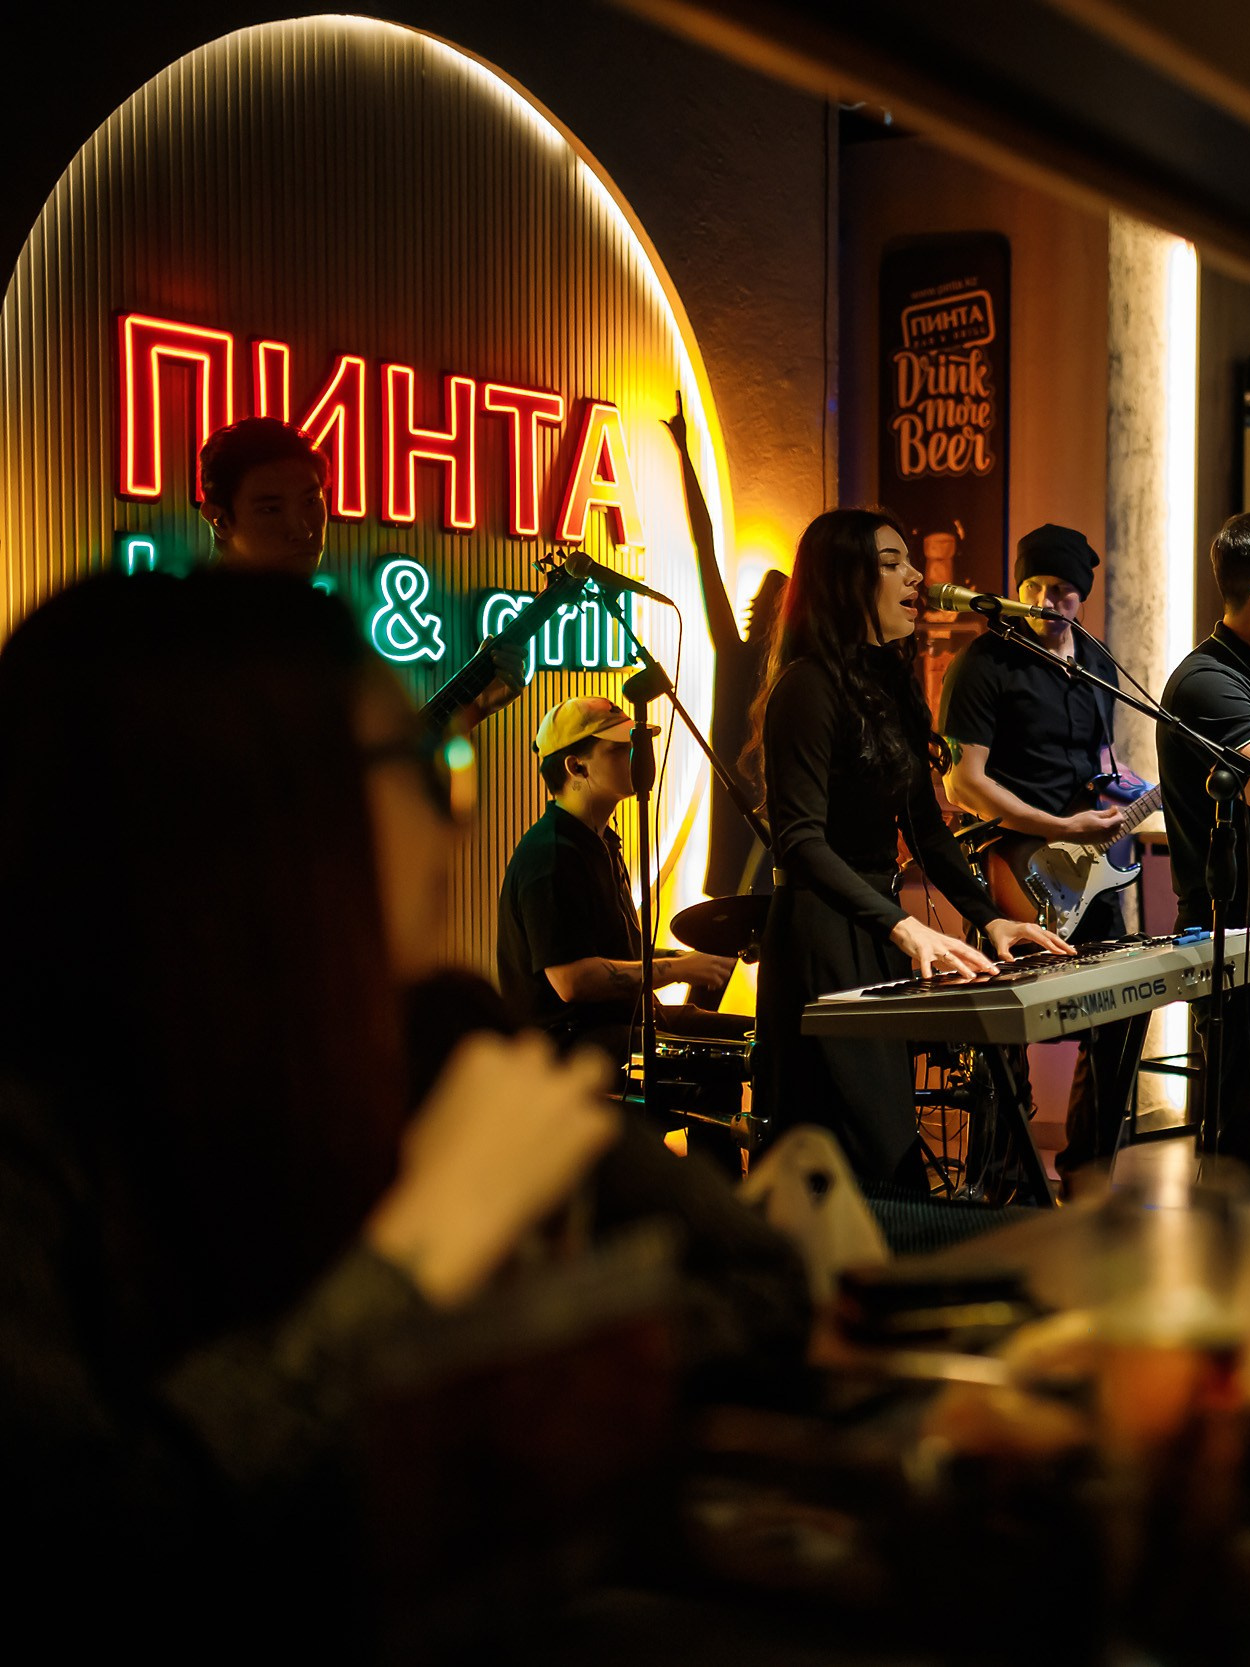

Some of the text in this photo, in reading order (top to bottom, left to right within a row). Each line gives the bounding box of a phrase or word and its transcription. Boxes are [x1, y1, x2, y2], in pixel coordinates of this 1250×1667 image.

[910, 304, 985, 337] ПИНТА
[893, 348, 990, 409] Drink
[118, 312, 645, 549] ПИНТА
[892, 412, 991, 476] Beer
